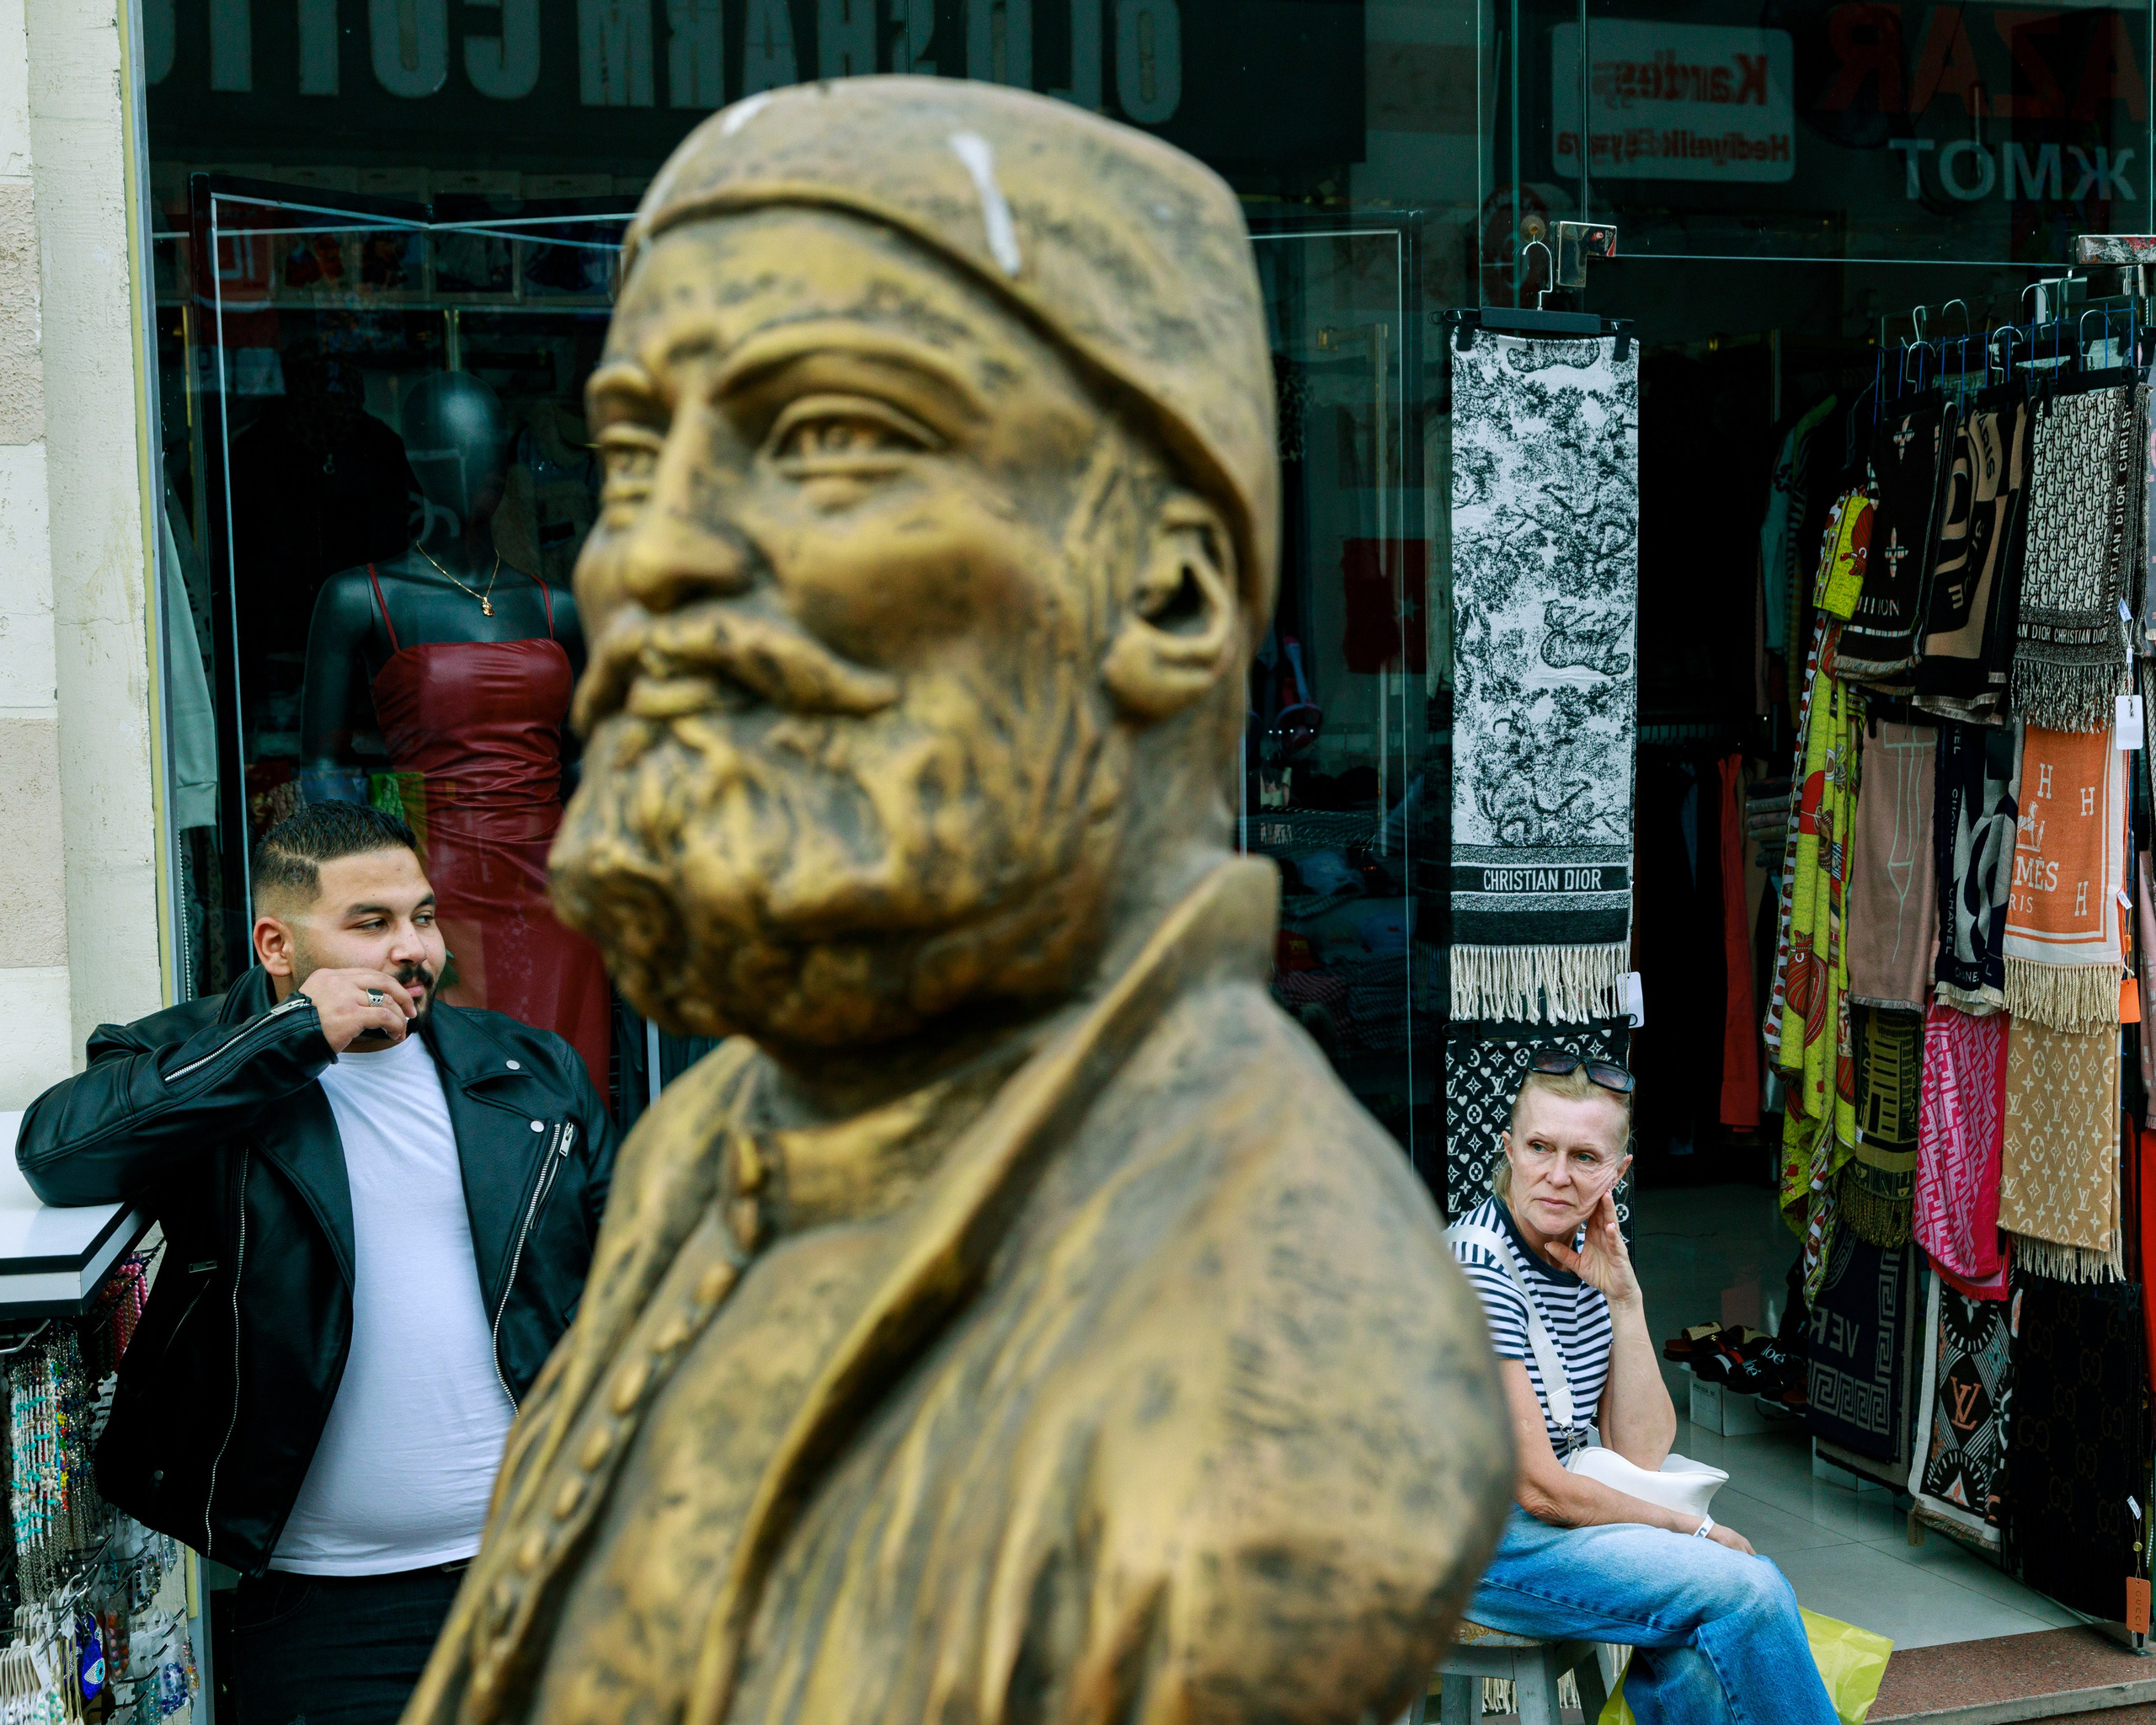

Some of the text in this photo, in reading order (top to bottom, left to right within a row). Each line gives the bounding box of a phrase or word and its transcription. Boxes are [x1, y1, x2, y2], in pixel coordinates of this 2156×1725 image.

[2104, 533, 2123, 624] CHRISTIAN
[2114, 483, 2127, 526] DIOR
[2031, 624, 2052, 640] DIOR
[2054, 628, 2091, 644] CHRISTIAN
[1483, 868, 1602, 891] CHRISTIAN DIOR
[2134, 1590, 2143, 1627] GUCCI
